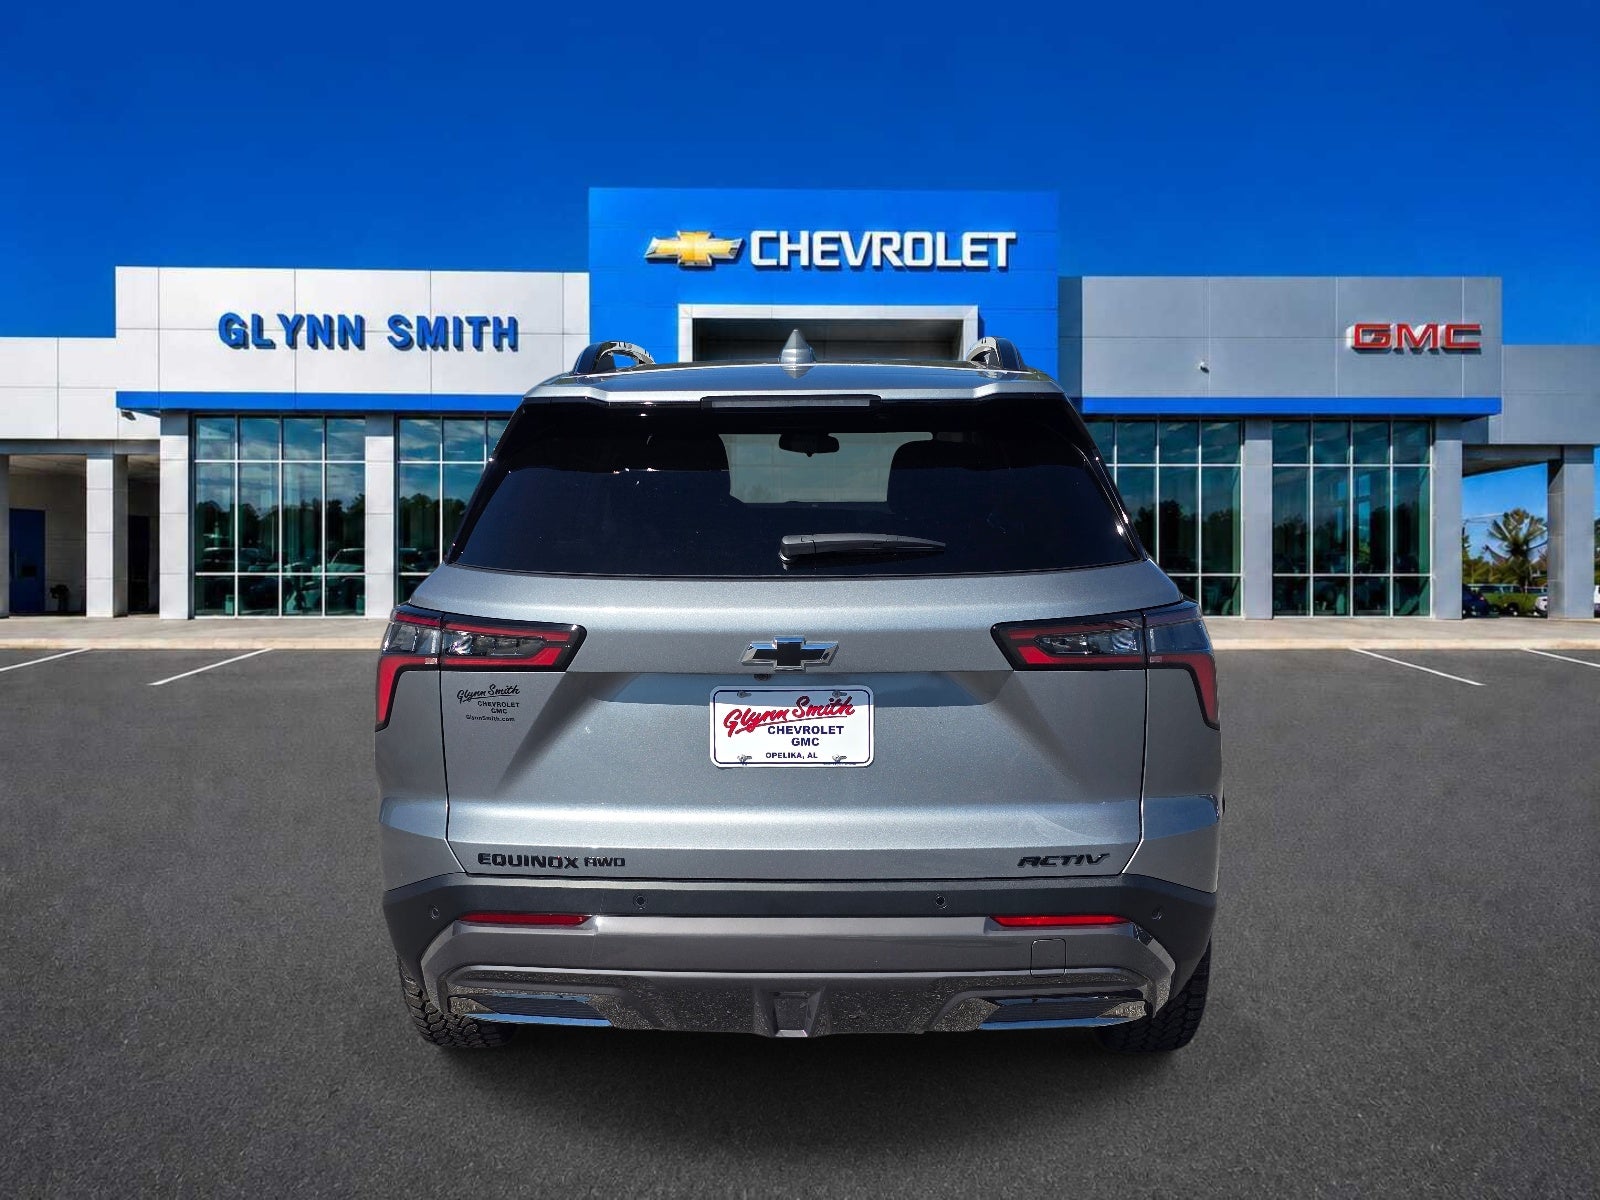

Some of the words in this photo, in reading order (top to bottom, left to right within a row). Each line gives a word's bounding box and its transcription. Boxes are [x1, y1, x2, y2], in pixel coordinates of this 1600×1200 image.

[750, 230, 1017, 268] CHEVROLET
[218, 312, 366, 350] GLYNN
[387, 314, 519, 352] SMITH
[1349, 323, 1482, 354] GMC
[457, 690, 487, 704] Glynn
[487, 683, 520, 696] Smith
[477, 700, 520, 708] CHEVROLET
[491, 707, 508, 715] GMC
[723, 708, 789, 738] Glynn
[792, 695, 855, 718] Smith
[767, 725, 845, 735] CHEVROLET
[791, 737, 820, 747] GMC
[765, 752, 805, 760] OPELIKA,
[477, 852, 579, 869] EQUINOX
[583, 856, 626, 867] AWD
[1017, 853, 1111, 868] ACTIV
